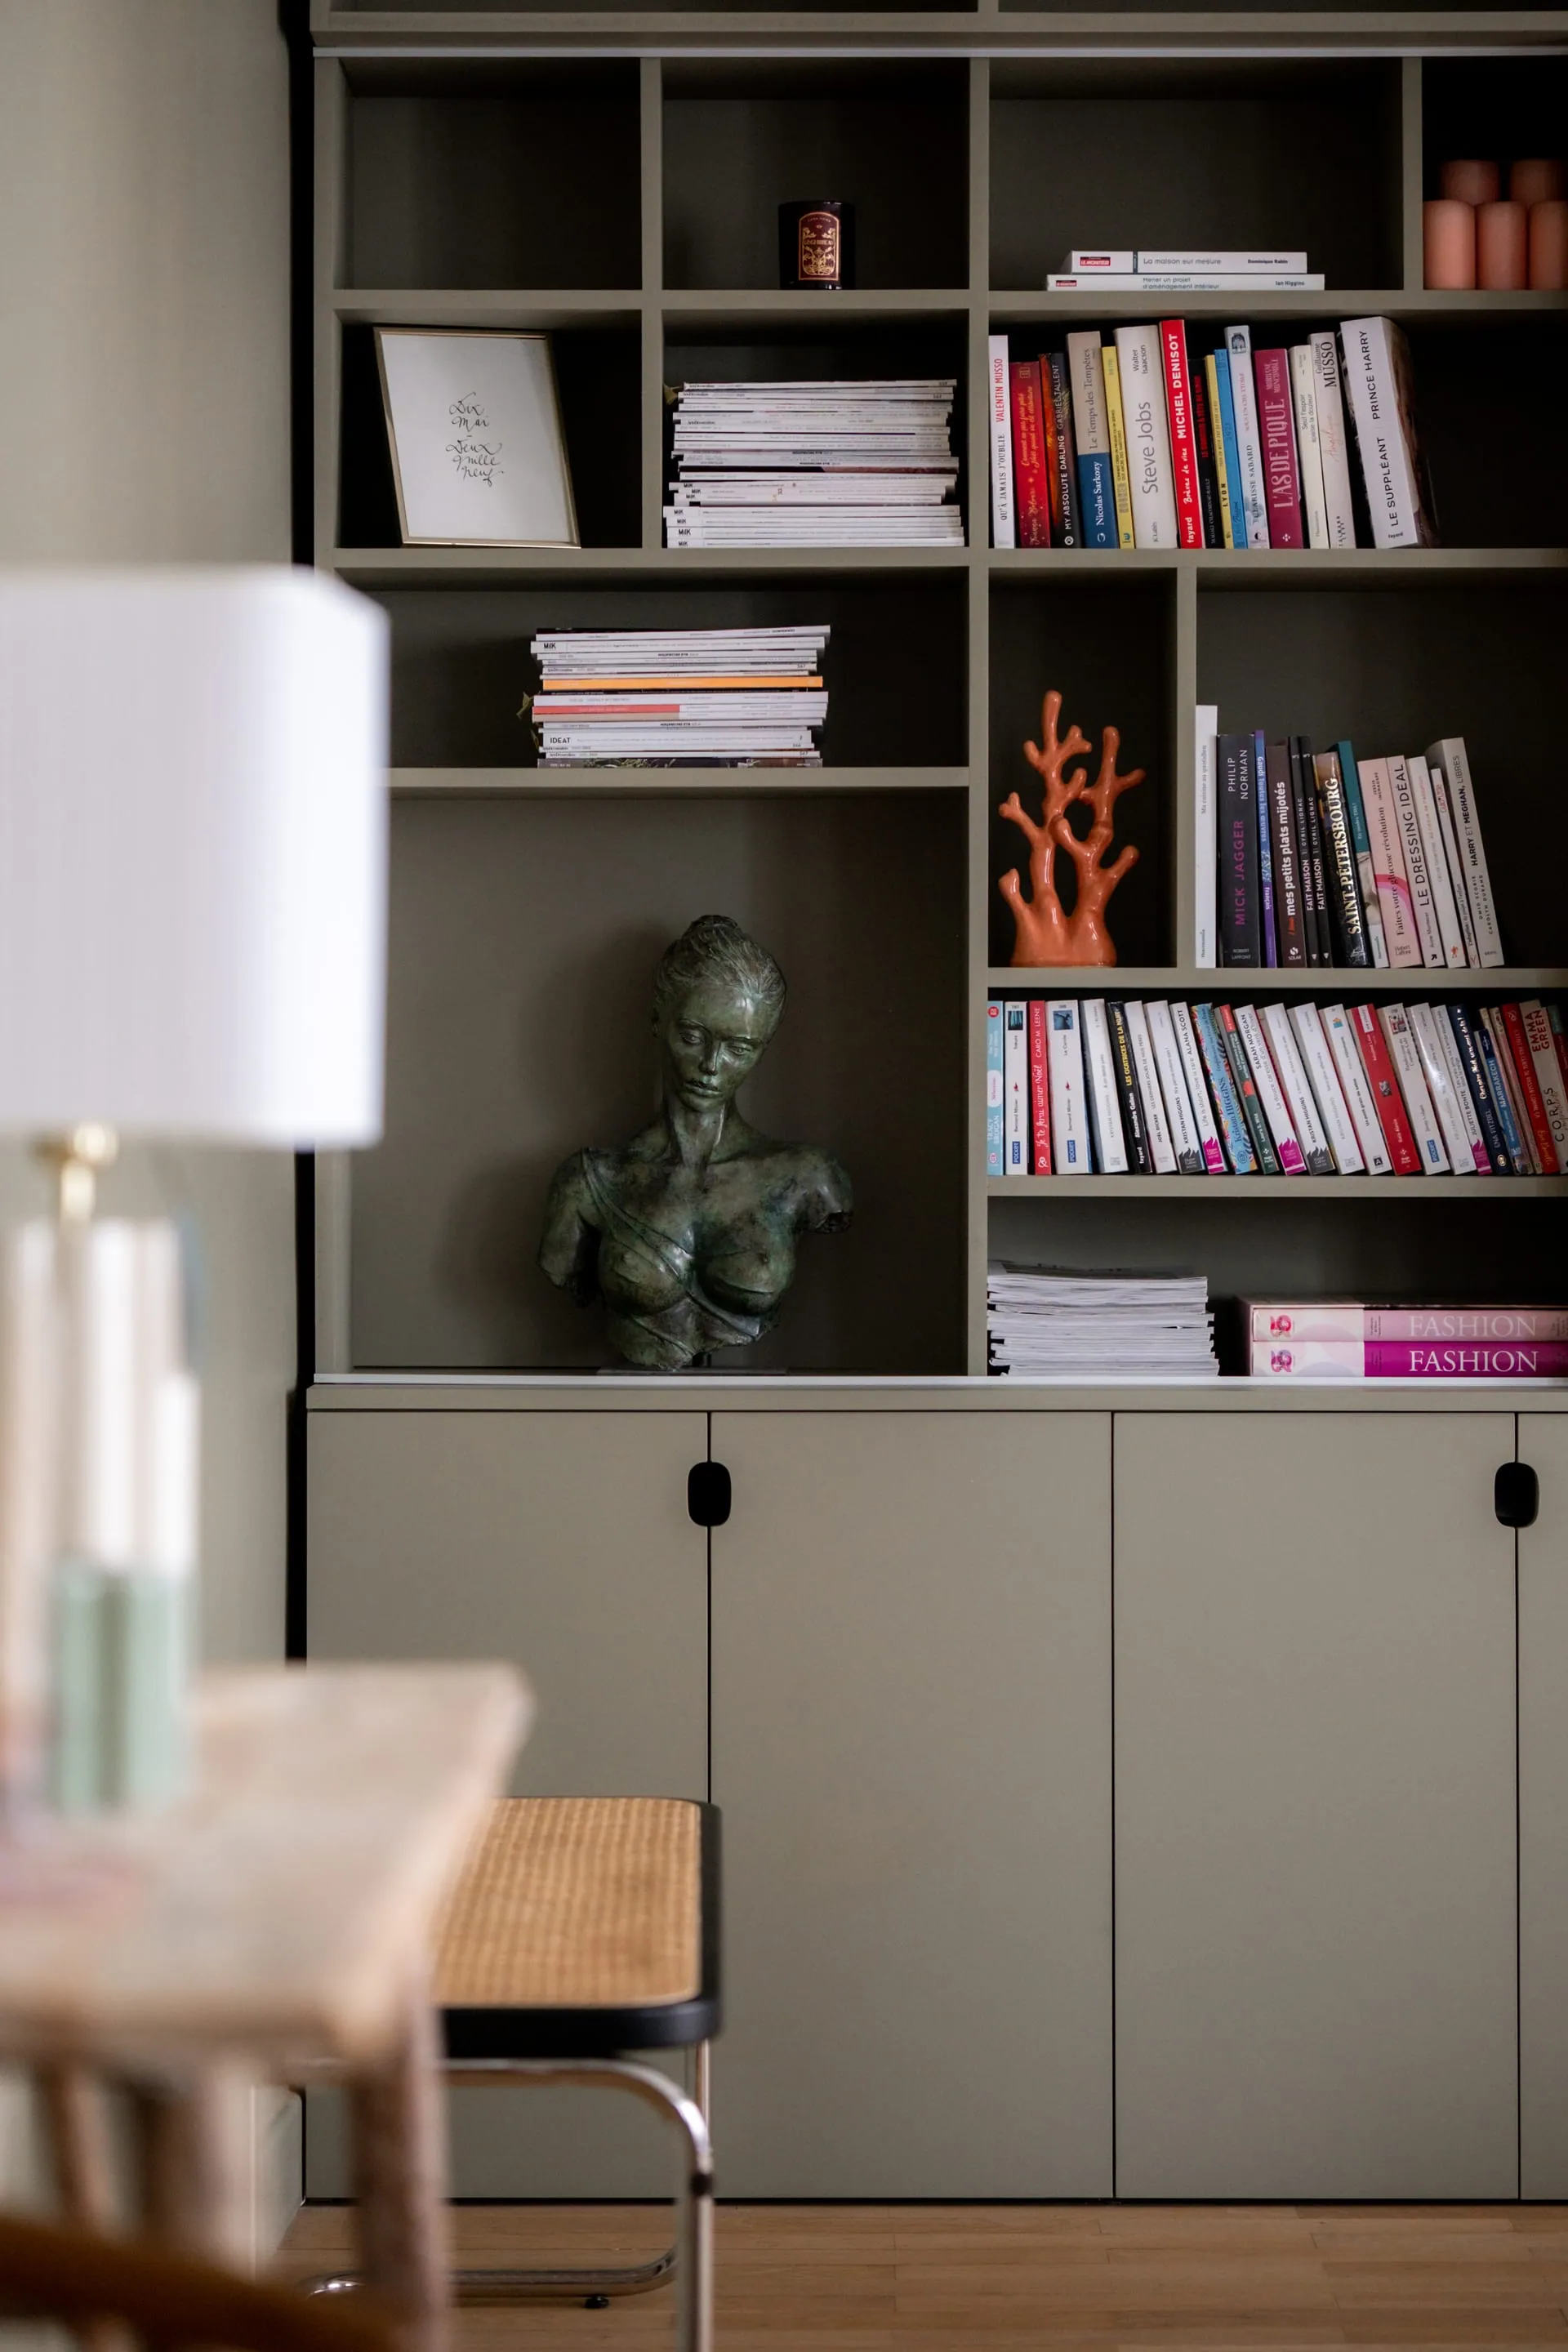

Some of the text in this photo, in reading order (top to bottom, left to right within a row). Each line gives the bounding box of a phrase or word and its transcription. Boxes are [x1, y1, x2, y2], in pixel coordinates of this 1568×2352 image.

[1139, 345, 1148, 373] Isaacson
[1314, 343, 1322, 373] Guillaume
[1321, 341, 1337, 387] MUSSO
[994, 359, 1004, 422] VALENTIN MUSSO
[1169, 334, 1186, 439] MICHEL DENISOT
[1359, 330, 1381, 419] PRINCE HARRY
[1052, 364, 1063, 429] GABRIEL TALLENT
[1082, 349, 1098, 448] Le Temps des Tempêtes
[1135, 402, 1158, 493] Steve Jobs
[1265, 399, 1294, 506] L'AS DE PIQUE
[1058, 435, 1071, 529] MY ABSOLUTE DARLING
[1181, 465, 1189, 474] de
[1377, 437, 1399, 526] LE SUPPLÉANT
[1093, 461, 1105, 525] Nicolas Sarkozy
[1181, 478, 1192, 503] Brèves
[1250, 480, 1259, 518] CLARISSE
[997, 503, 1007, 520] QU'À
[1185, 517, 1194, 542] fayard
[1227, 758, 1236, 791] PHILIP
[1240, 750, 1249, 800] NORMAN
[1257, 778, 1265, 801] Toutes
[1394, 764, 1410, 808] IDÉAL
[1276, 782, 1290, 824] mijotés
[1453, 755, 1478, 866] HARRY ET MEGHAN, LIBRES
[1279, 826, 1293, 854] plats
[1325, 777, 1361, 934] SAINT-PÉTERSBOURG
[1403, 812, 1426, 884] DRESSING
[1234, 821, 1245, 925] MICK JAGGER
[1281, 857, 1296, 889] petits
[1303, 860, 1312, 892] MAISON
[1313, 859, 1325, 910] FAIT MAISON
[1377, 807, 1405, 936] Faites votre glucose révolution
[1285, 891, 1296, 915] mes
[1418, 889, 1430, 906] LE
[1114, 1011, 1122, 1025] NUIT
[1178, 1009, 1192, 1055] ALANA SCOTT
[1241, 1014, 1254, 1045] MORGAN
[1248, 1013, 1259, 1032] d'hiver
[1525, 1013, 1541, 1052] EMMA
[1535, 1010, 1549, 1049] GREEN
[1119, 1035, 1125, 1043] DE
[1258, 1049, 1267, 1059] d'un
[1120, 1045, 1130, 1074] CICATRICES
[1252, 1046, 1262, 1069] SARAH
[1263, 1061, 1275, 1082] caresse
[1033, 1065, 1043, 1083] Noël
[1193, 1078, 1201, 1089] love
[1488, 1060, 1507, 1108] MARRAKECH
[1035, 1085, 1045, 1107] aimer
[1196, 1090, 1205, 1107] short,
[1219, 1078, 1237, 1115] HIGGINS
[1270, 1085, 1280, 1102] douce
[1036, 1110, 1048, 1126] ferai
[1175, 1097, 1189, 1143] KRISTAN HIGGINS
[1300, 1097, 1316, 1143] KRISTAN HIGGINS
[1460, 1090, 1477, 1135] JULIETTE BONTE
[1544, 1088, 1564, 1142] CORPS
[1038, 1139, 1049, 1147] Je
[1230, 1116, 1242, 1143] Kristan
[1409, 1315, 1536, 1338] FASHION
[1409, 1351, 1539, 1372] FASHION
